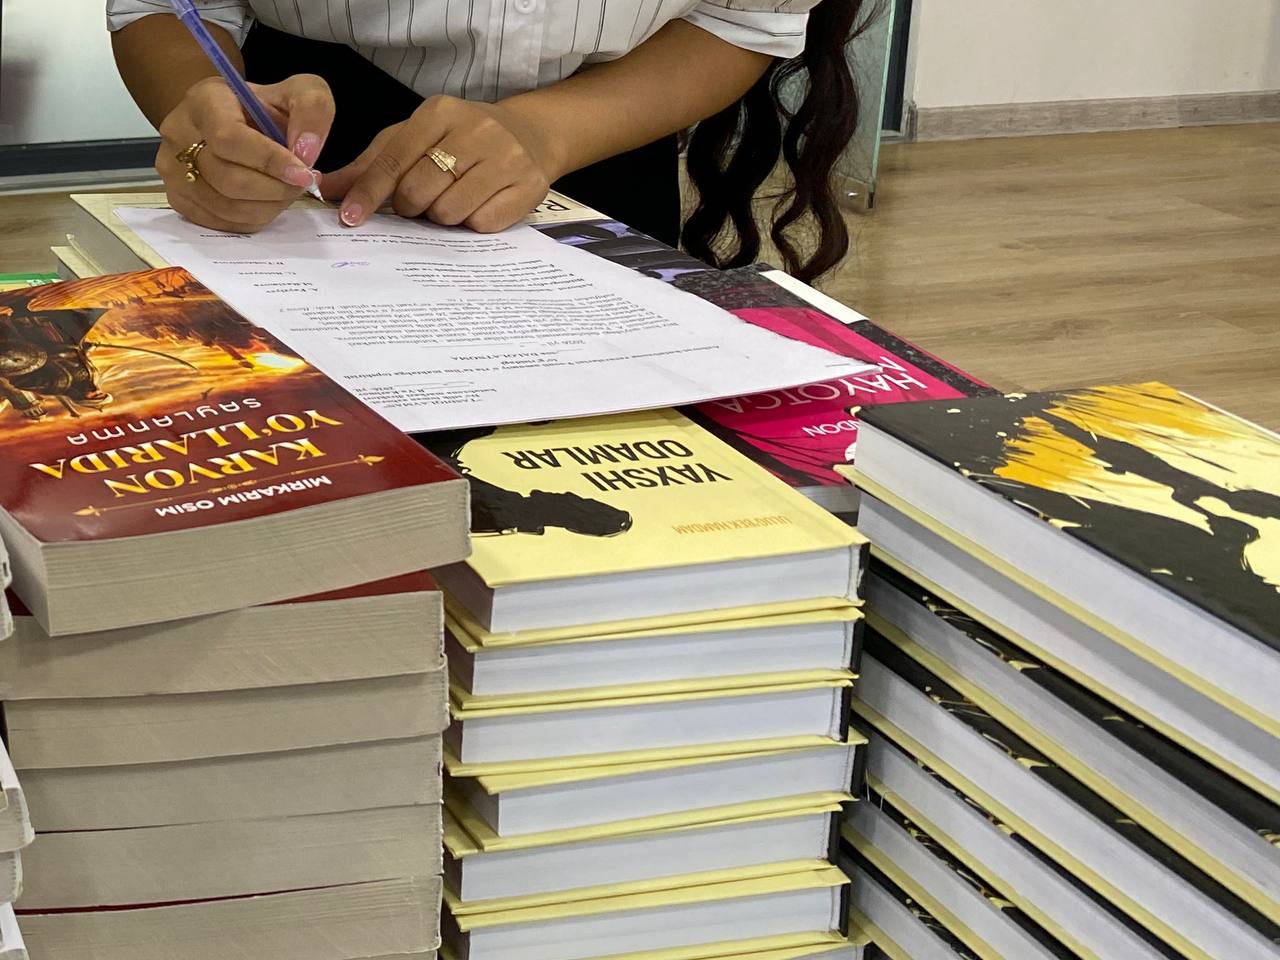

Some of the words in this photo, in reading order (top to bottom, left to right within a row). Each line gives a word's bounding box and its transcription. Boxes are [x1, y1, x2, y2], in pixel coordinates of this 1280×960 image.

[801, 418, 862, 438] NDON
[103, 437, 327, 499] KARVON
[501, 439, 695, 470] ODAMLAR
[216, 475, 333, 508] MIRKARIM
[580, 462, 734, 493] YAXSHI
[155, 499, 214, 517] OSIM
[670, 521, 729, 535] HAMDAM
